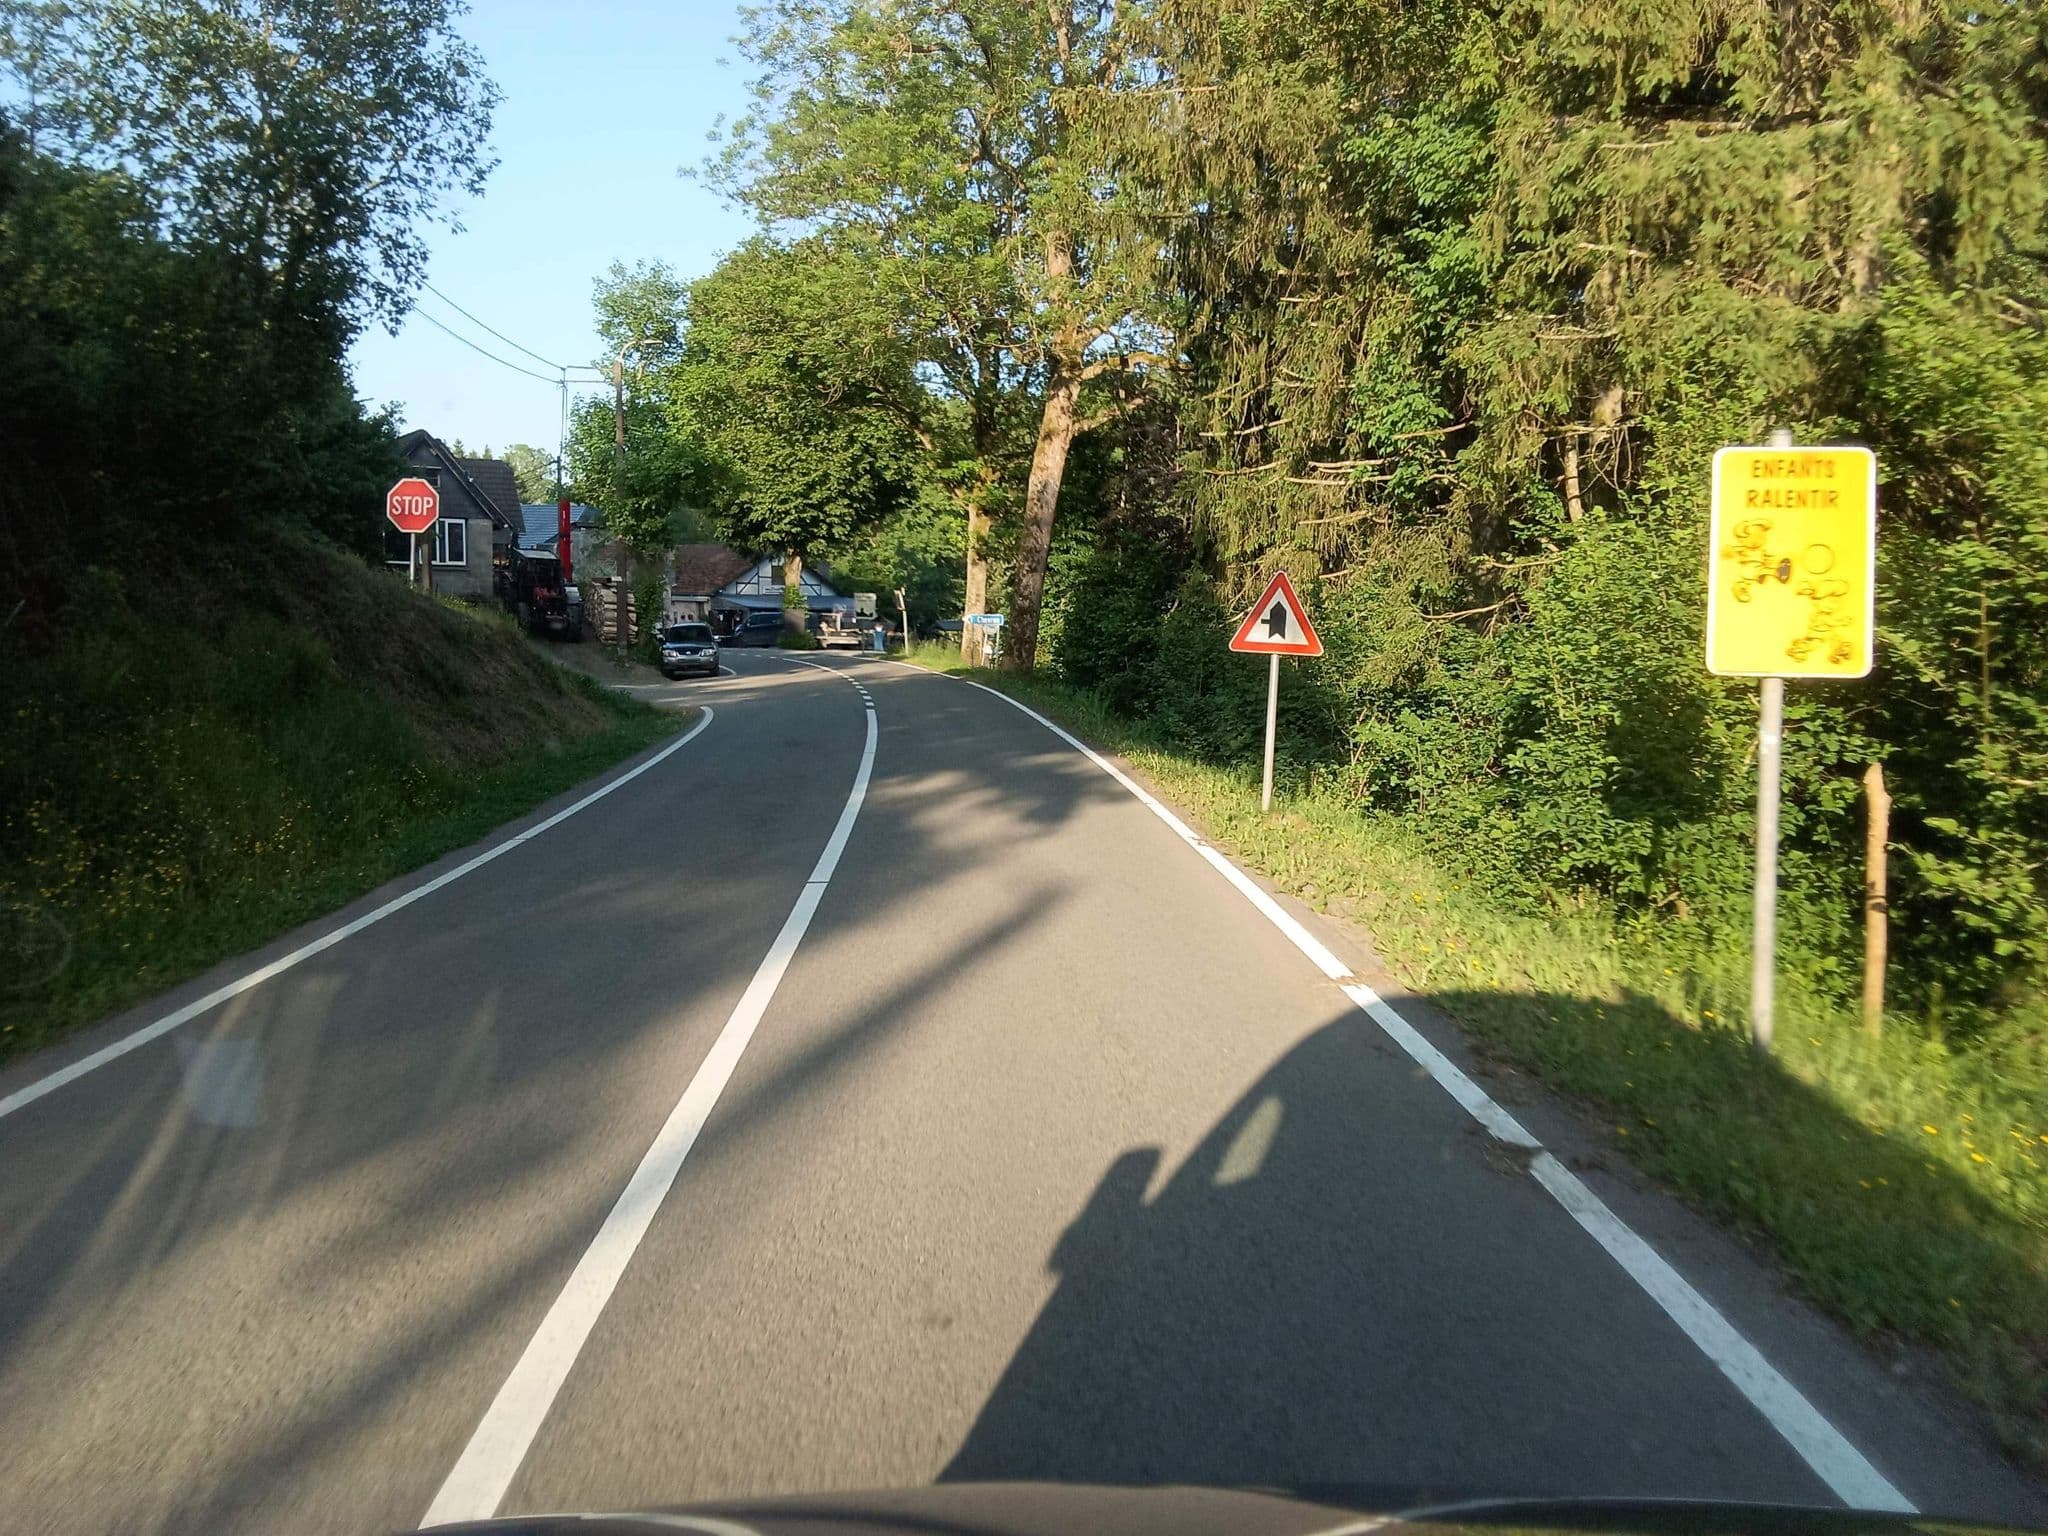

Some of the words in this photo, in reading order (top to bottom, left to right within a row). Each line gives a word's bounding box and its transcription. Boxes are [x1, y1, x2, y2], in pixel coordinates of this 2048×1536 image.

[1753, 459, 1835, 478] ENFANTS
[392, 496, 433, 516] STOP
[1747, 489, 1839, 508] RALENTIR
